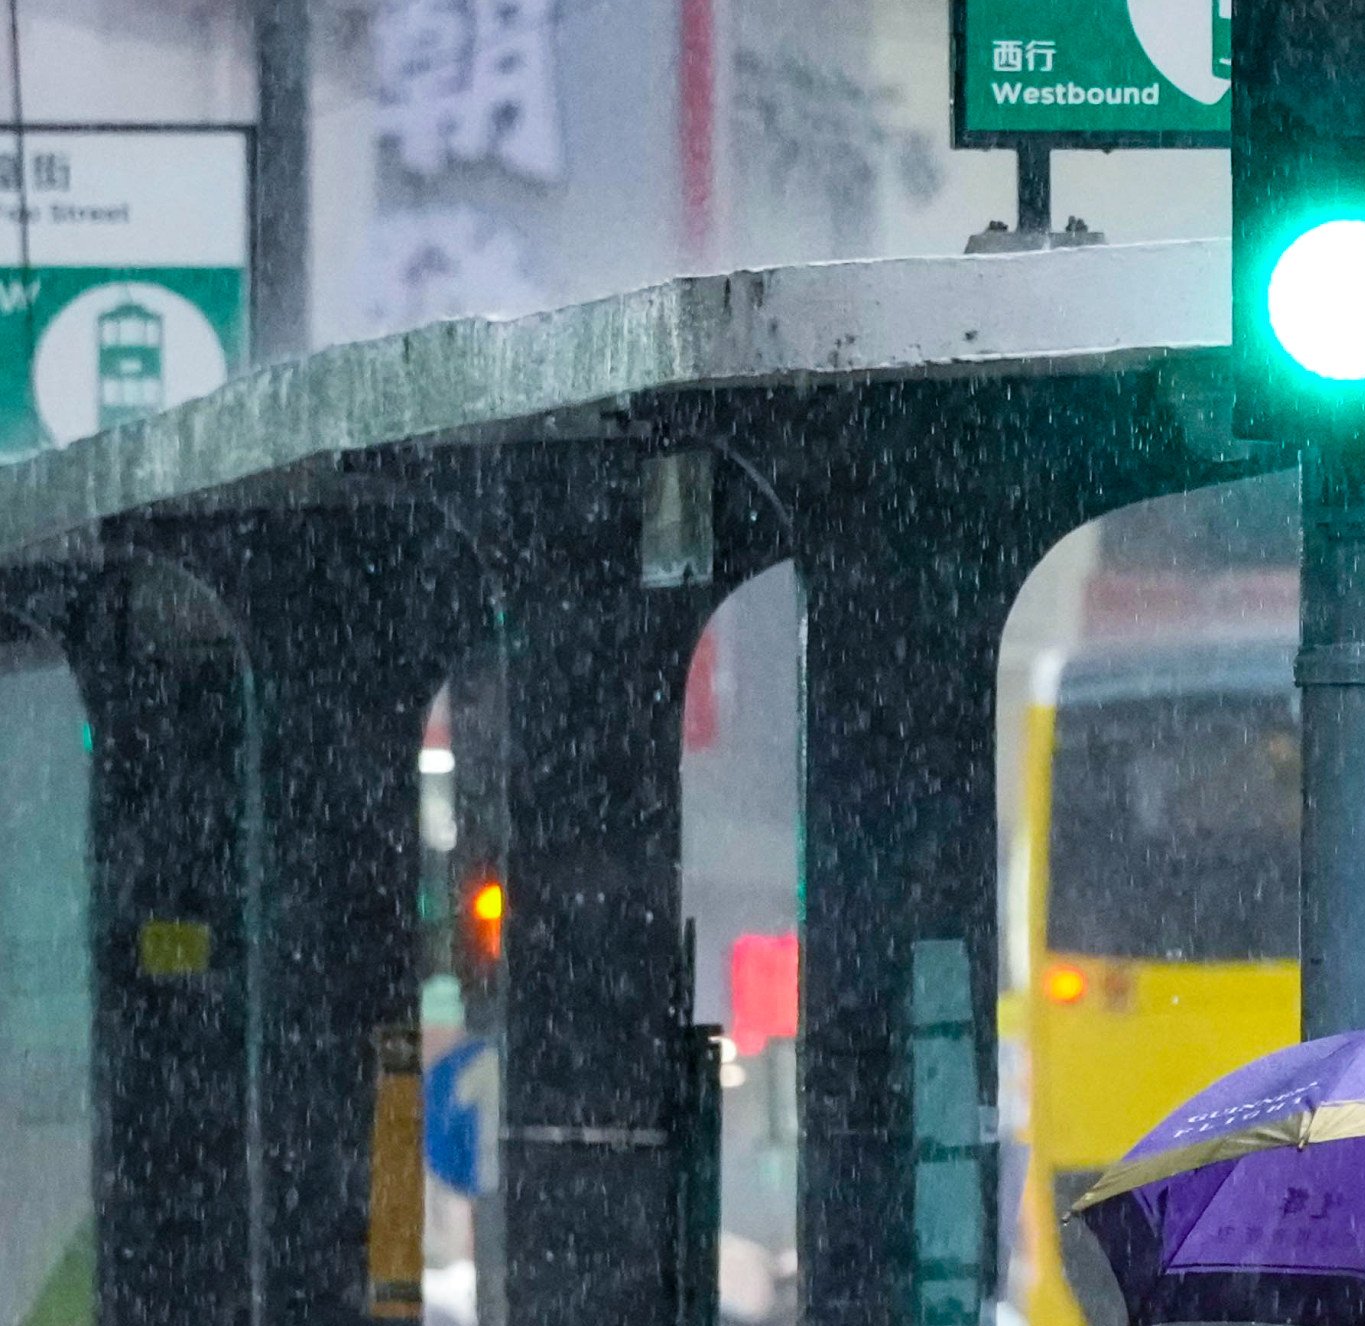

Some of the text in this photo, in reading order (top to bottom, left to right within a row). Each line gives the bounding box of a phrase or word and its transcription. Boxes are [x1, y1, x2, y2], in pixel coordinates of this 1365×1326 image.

[992, 40, 1057, 72] 西行
[991, 82, 1160, 106] Westbound
[50, 202, 130, 225] Street
